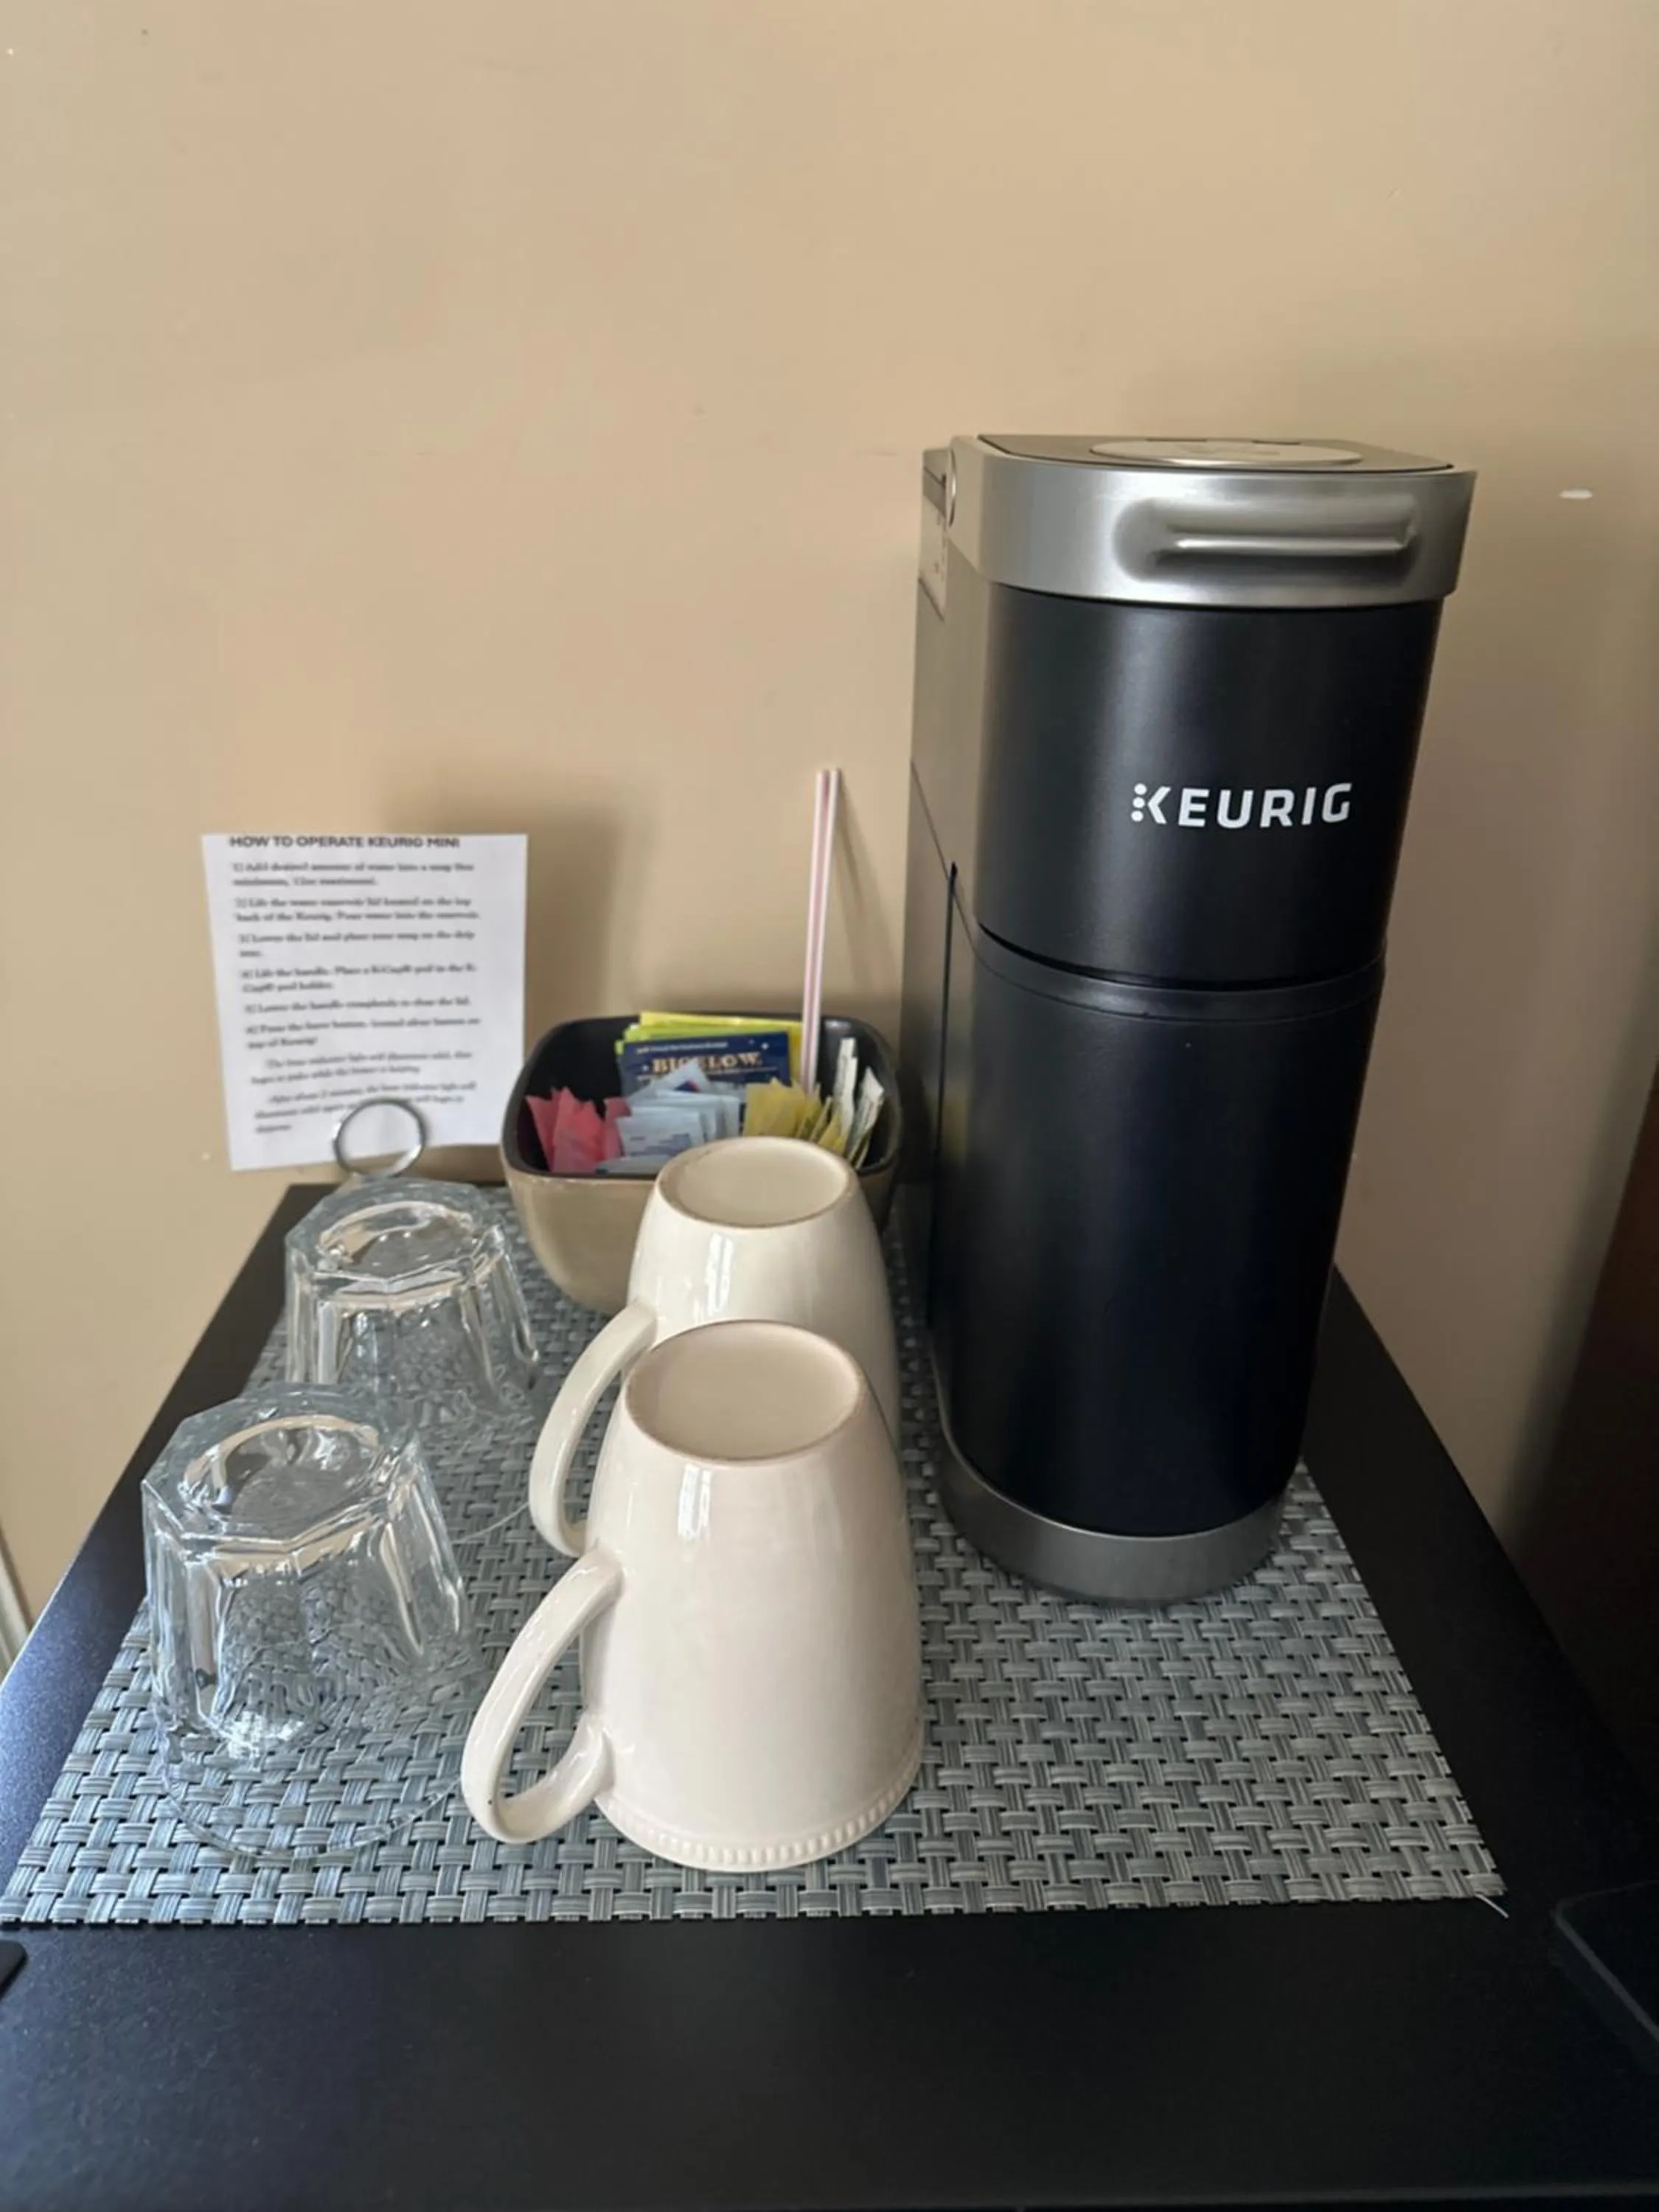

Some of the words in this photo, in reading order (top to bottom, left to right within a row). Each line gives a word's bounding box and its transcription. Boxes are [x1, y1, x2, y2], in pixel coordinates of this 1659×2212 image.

[1130, 782, 1352, 829] KEURIG
[230, 835, 269, 847] HOW
[272, 835, 293, 847] TO
[296, 835, 364, 847] OPERATE
[368, 836, 423, 847] KEURIG
[425, 837, 460, 848] MINI
[652, 1051, 761, 1074] BIGLOW
